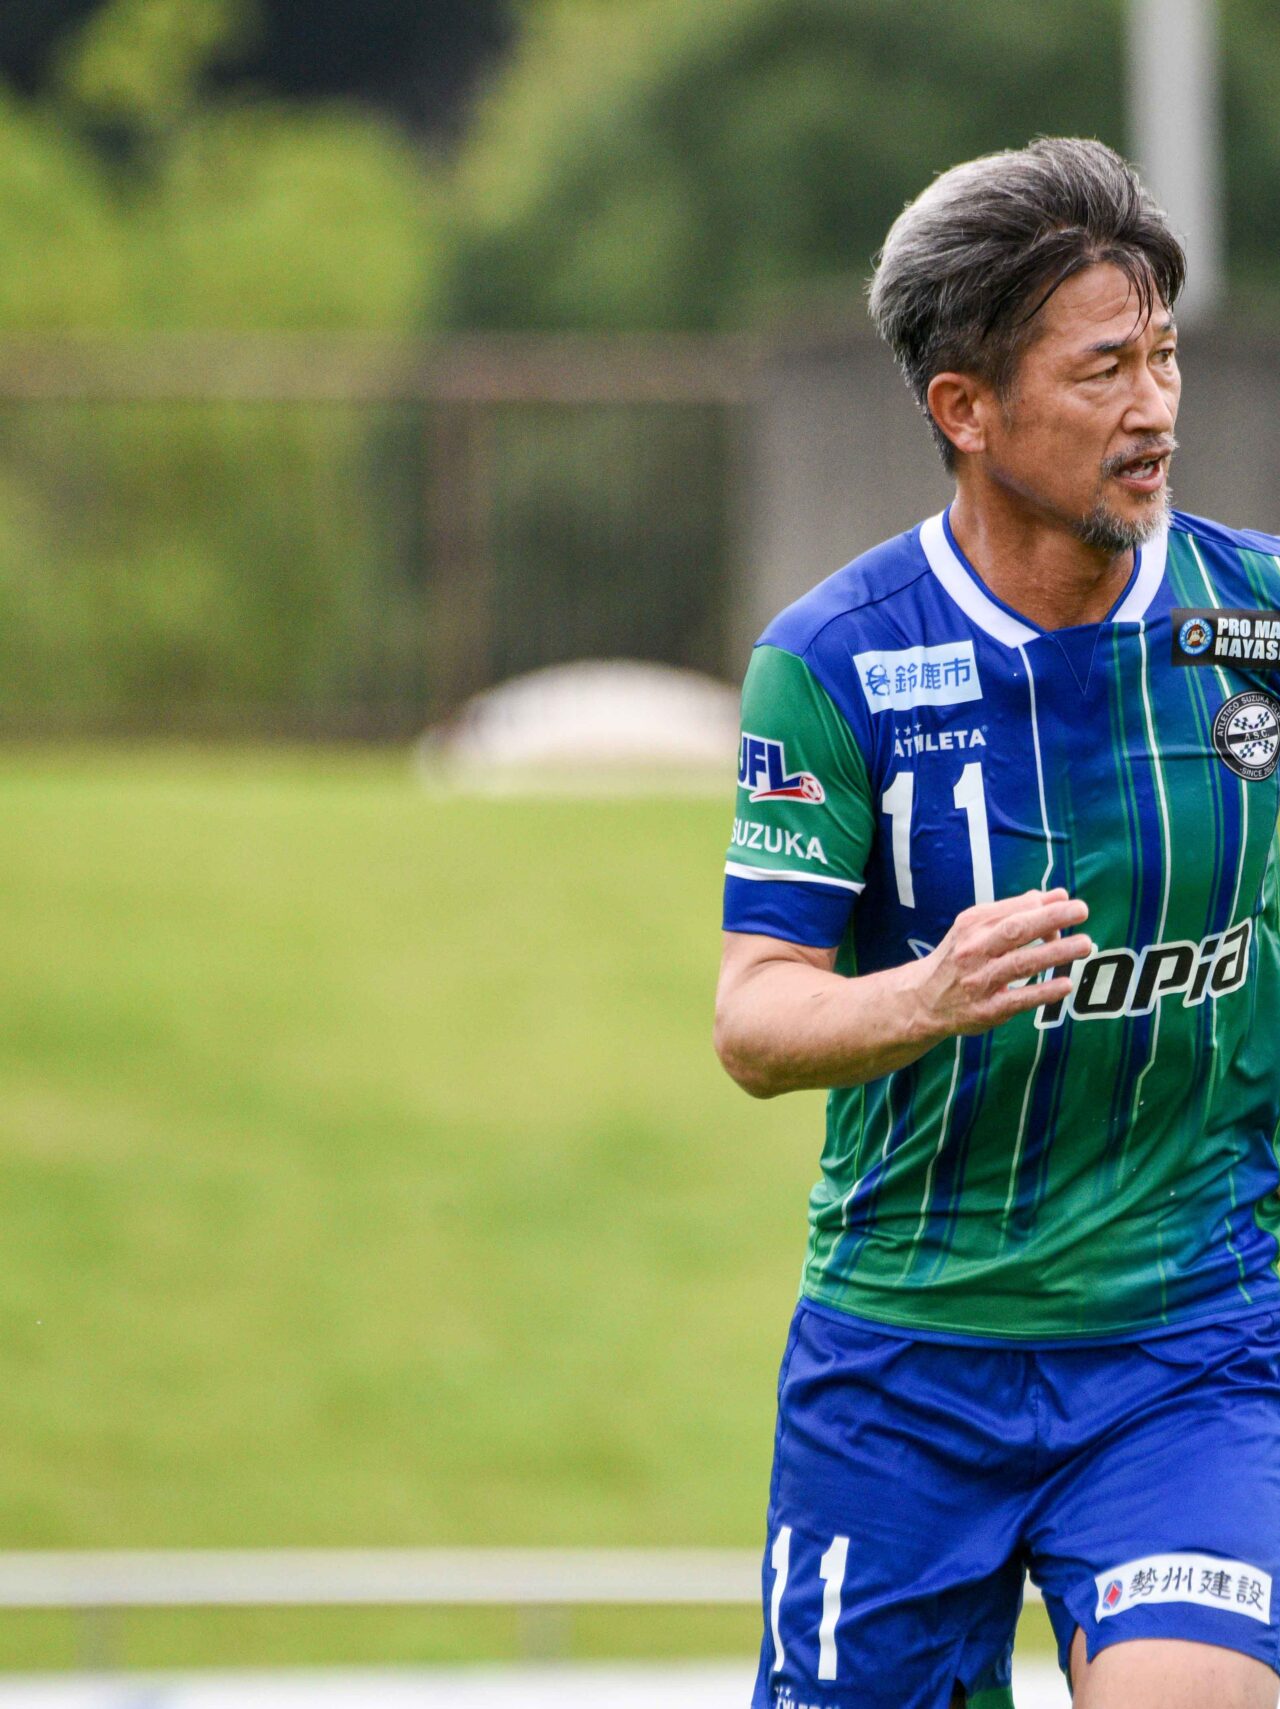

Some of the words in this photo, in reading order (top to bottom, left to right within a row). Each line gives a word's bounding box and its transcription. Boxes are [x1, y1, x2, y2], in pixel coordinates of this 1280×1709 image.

[1217, 618, 1251, 637] PRO
[895, 658, 971, 693] 鈴鹿市
[1216, 702, 1240, 737] ATLETICO
[1241, 694, 1269, 705] SUZUKA
[882, 762, 995, 909] 11
[770, 1525, 850, 1681] 11
[1129, 1566, 1264, 1612] 勢州建設
